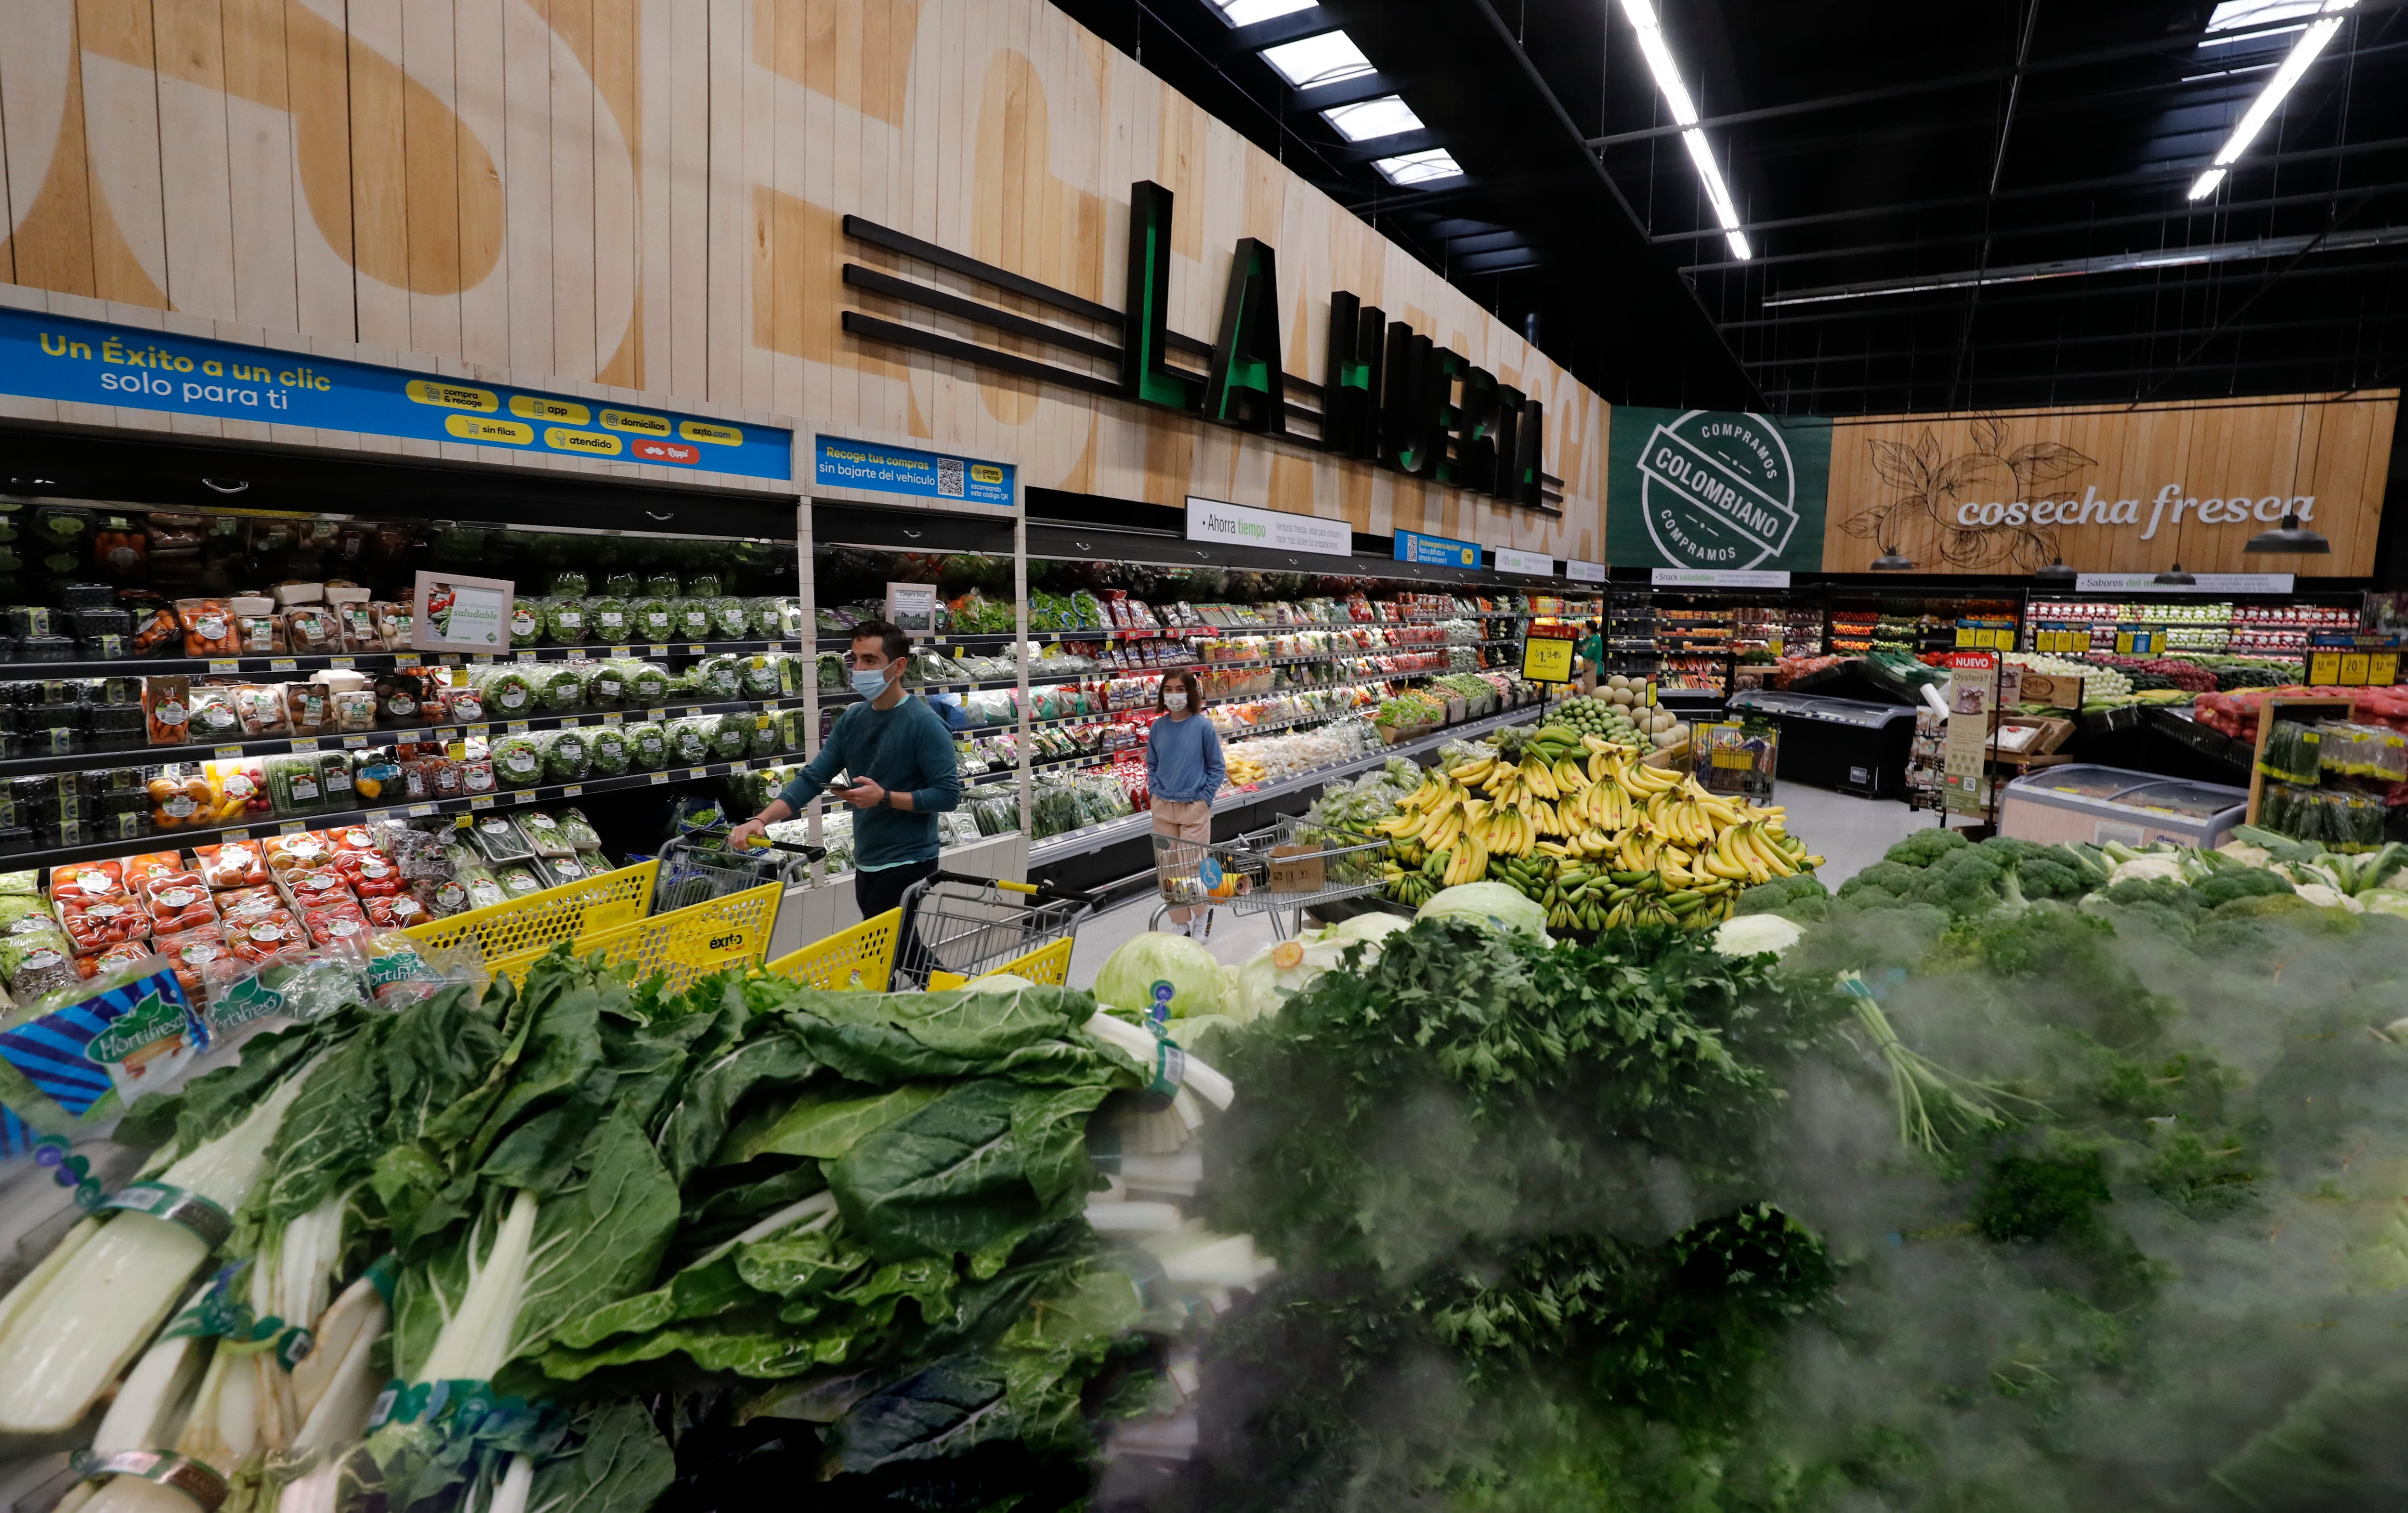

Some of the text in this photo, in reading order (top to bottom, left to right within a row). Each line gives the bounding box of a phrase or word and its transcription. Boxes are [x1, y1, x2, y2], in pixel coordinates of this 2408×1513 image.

[1122, 180, 1286, 436] LA
[40, 332, 331, 391] Un Éxito a un clic
[101, 371, 288, 410] solo para ti
[444, 389, 478, 399] compra
[452, 397, 482, 408] recoge
[548, 406, 567, 416] app
[621, 417, 665, 431] domicilios
[483, 425, 516, 436] sin filas
[569, 436, 612, 449] atendido
[667, 447, 689, 459] Rappi
[1702, 423, 1777, 479] COMPRAMOS
[826, 446, 929, 470] Recoge tus compras
[819, 462, 935, 486] sin bajarte del vehículo
[970, 483, 1001, 492] escaneando
[1655, 447, 1779, 538] COLOMBIANO
[982, 491, 1000, 500] código
[1957, 484, 2316, 540] cosecha fresca
[1208, 514, 1266, 540] Ahorra tiempo
[1661, 509, 1736, 561] COMPRAMOS
[1659, 573, 1714, 582] Snack saludables
[2087, 579, 2123, 587] Sabores
[2126, 579, 2141, 587] del
[453, 609, 498, 620] saludable
[1956, 657, 1989, 668] NUEVO
[1954, 673, 1989, 683] Oysters?
